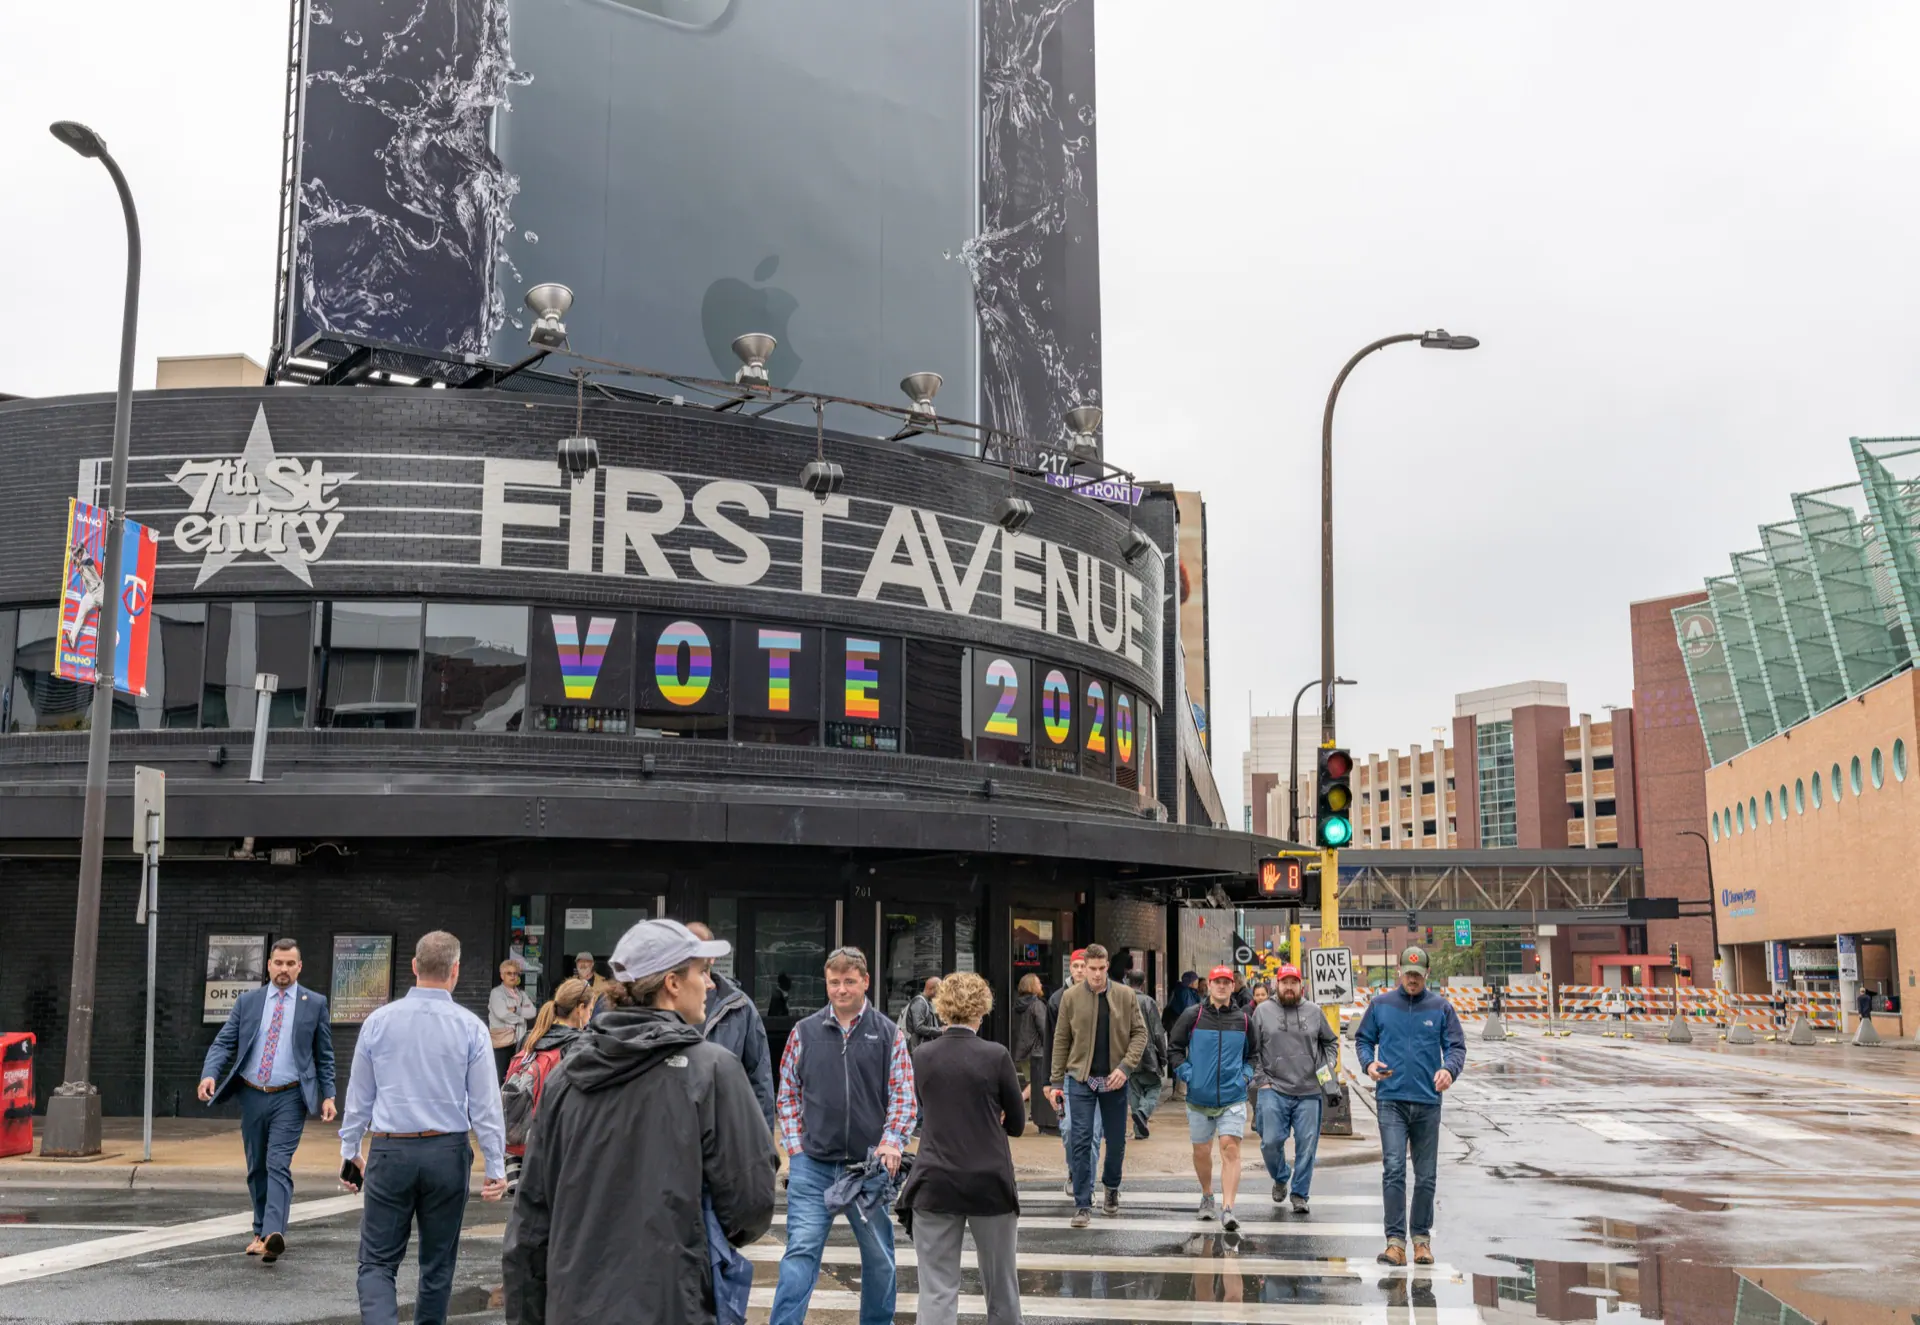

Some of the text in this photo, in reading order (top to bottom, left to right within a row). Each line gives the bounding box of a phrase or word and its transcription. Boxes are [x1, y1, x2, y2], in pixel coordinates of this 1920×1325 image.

[1038, 452, 1068, 474] 217
[176, 457, 341, 514] 7th St
[173, 503, 345, 563] entry
[480, 457, 1144, 666] FIRST AVENUE
[1687, 620, 1708, 648] A
[551, 613, 1132, 764] VOTE 2020
[1288, 866, 1299, 889] 8
[855, 886, 871, 898] 701
[1316, 953, 1346, 966] ONE
[1316, 968, 1347, 982] WAY
[210, 989, 228, 999] OH
